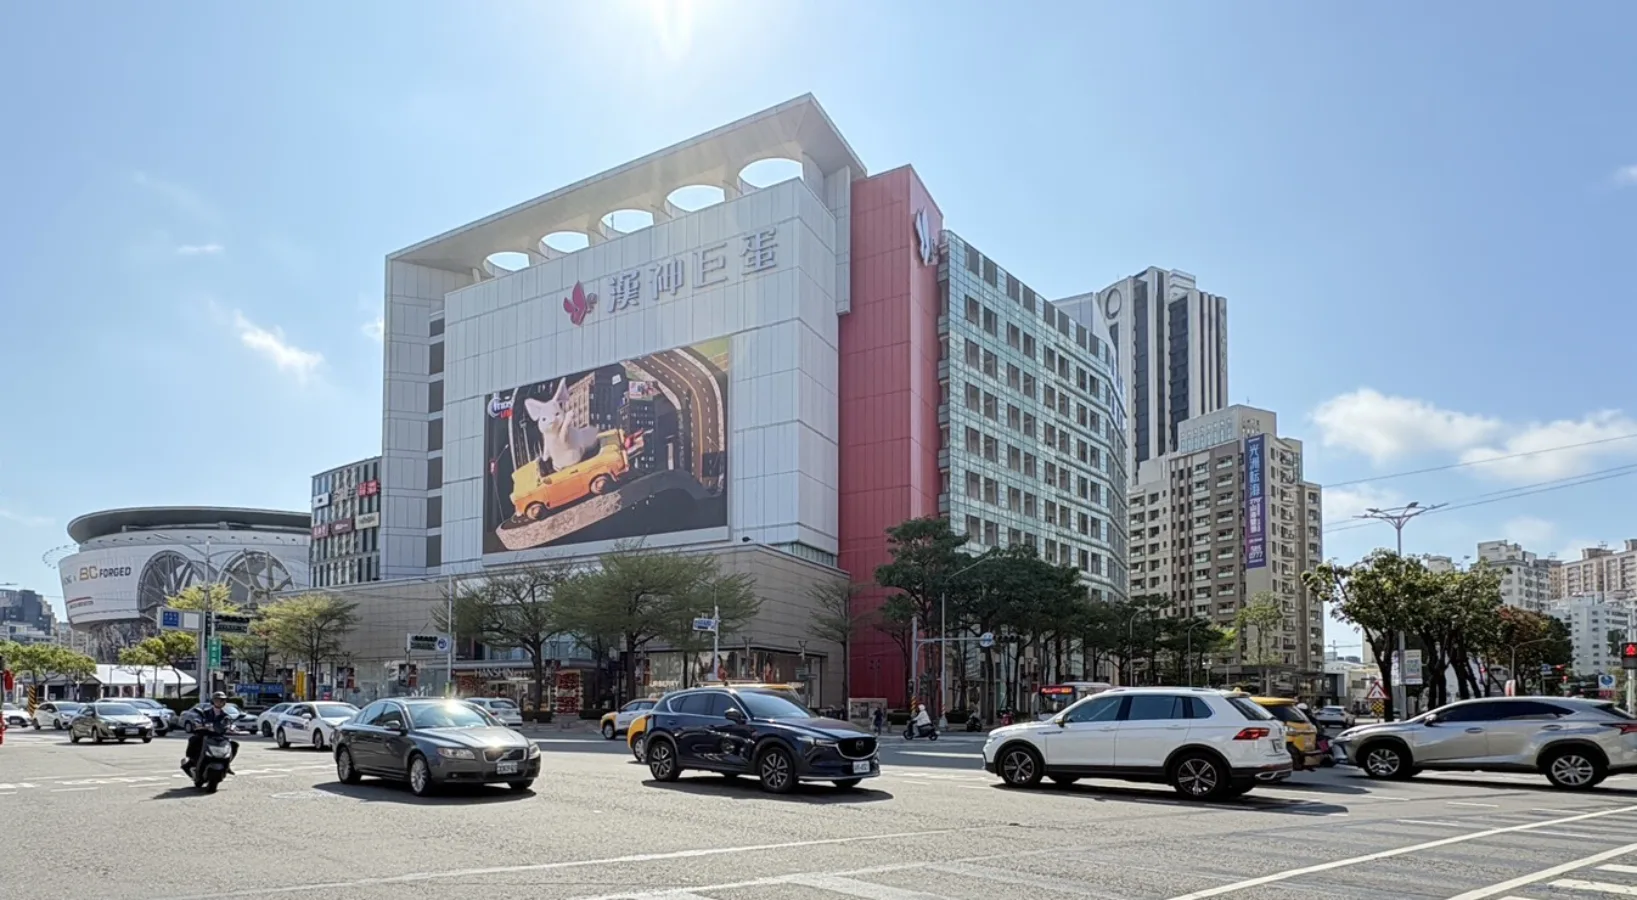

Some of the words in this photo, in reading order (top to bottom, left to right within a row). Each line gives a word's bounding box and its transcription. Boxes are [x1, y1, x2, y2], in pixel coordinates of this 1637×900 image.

[608, 227, 778, 313] 漢神巨蛋
[79, 566, 98, 581] BC
[99, 567, 132, 579] FORGED
